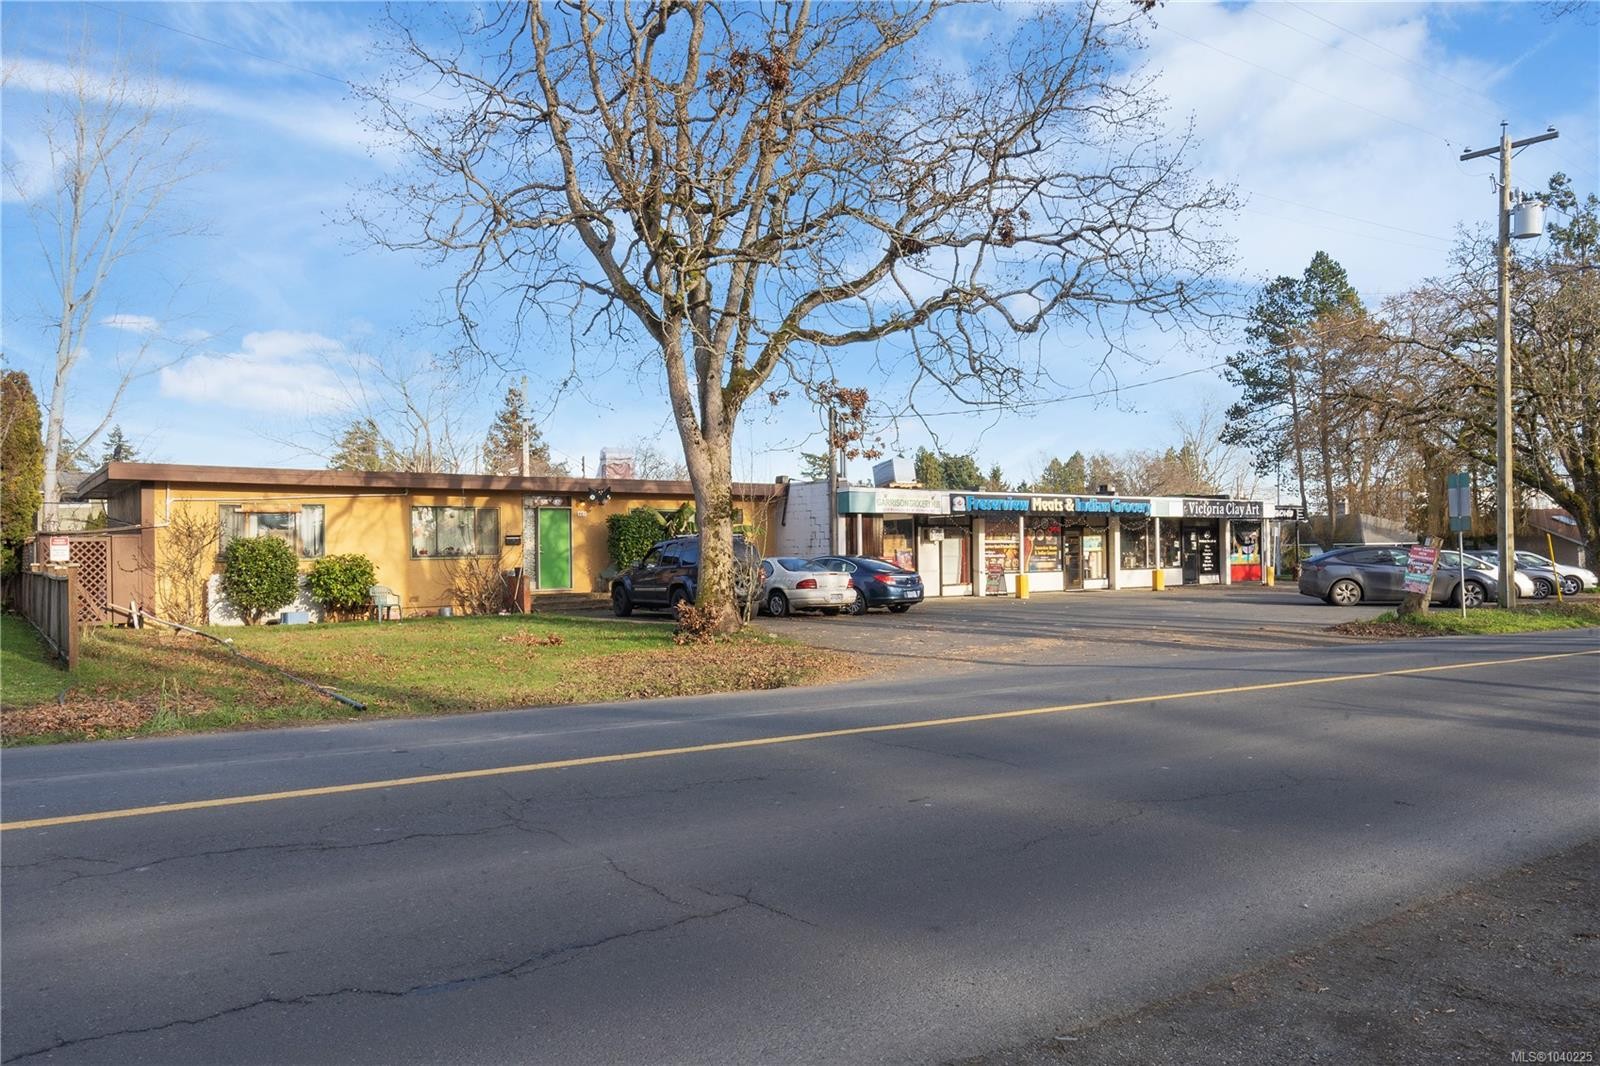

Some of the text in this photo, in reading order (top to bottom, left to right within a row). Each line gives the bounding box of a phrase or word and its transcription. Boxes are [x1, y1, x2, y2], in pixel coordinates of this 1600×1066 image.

[1031, 497, 1063, 512] Meats
[1064, 498, 1074, 512] &
[1075, 497, 1110, 512] Indian
[1111, 498, 1151, 516] Grocery
[1189, 501, 1224, 515] Victoria
[1226, 503, 1244, 517] Clay
[1246, 504, 1259, 515] Art
